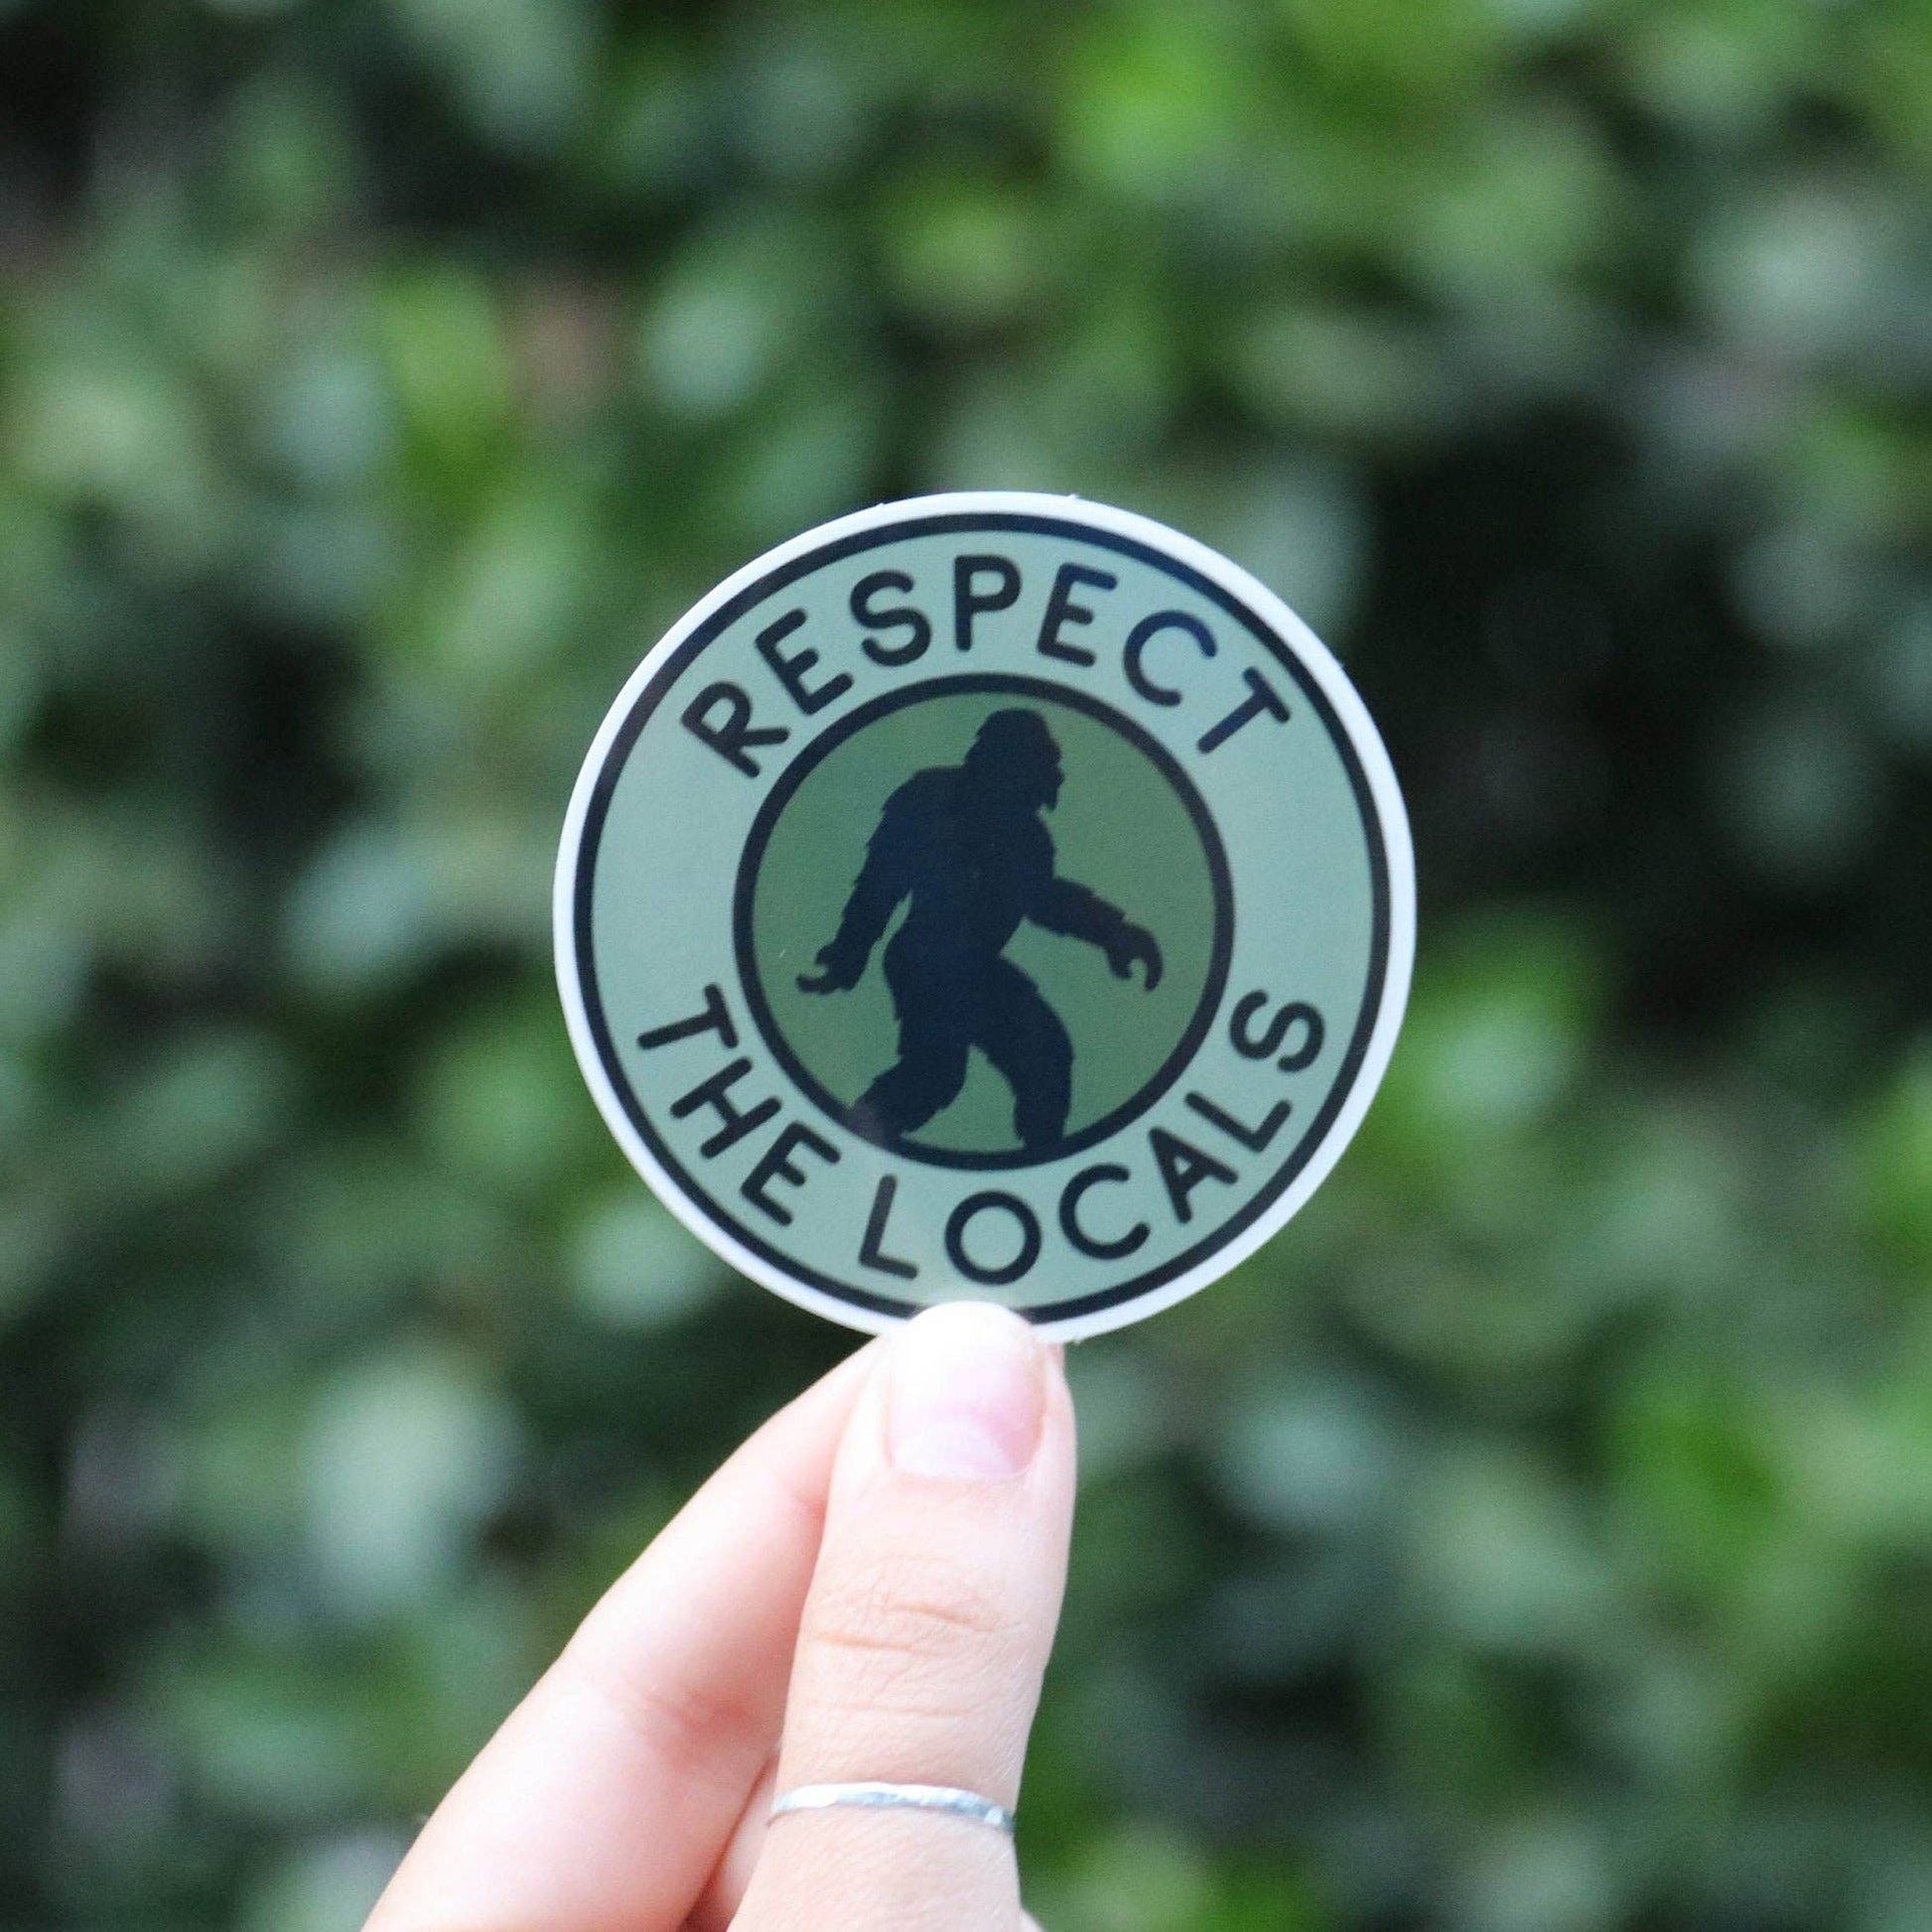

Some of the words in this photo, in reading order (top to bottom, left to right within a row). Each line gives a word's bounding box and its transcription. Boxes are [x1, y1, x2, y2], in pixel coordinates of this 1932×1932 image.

[681, 554, 1290, 778] RESPECT
[637, 984, 841, 1227] THE
[858, 990, 1325, 1286] LOCALS
